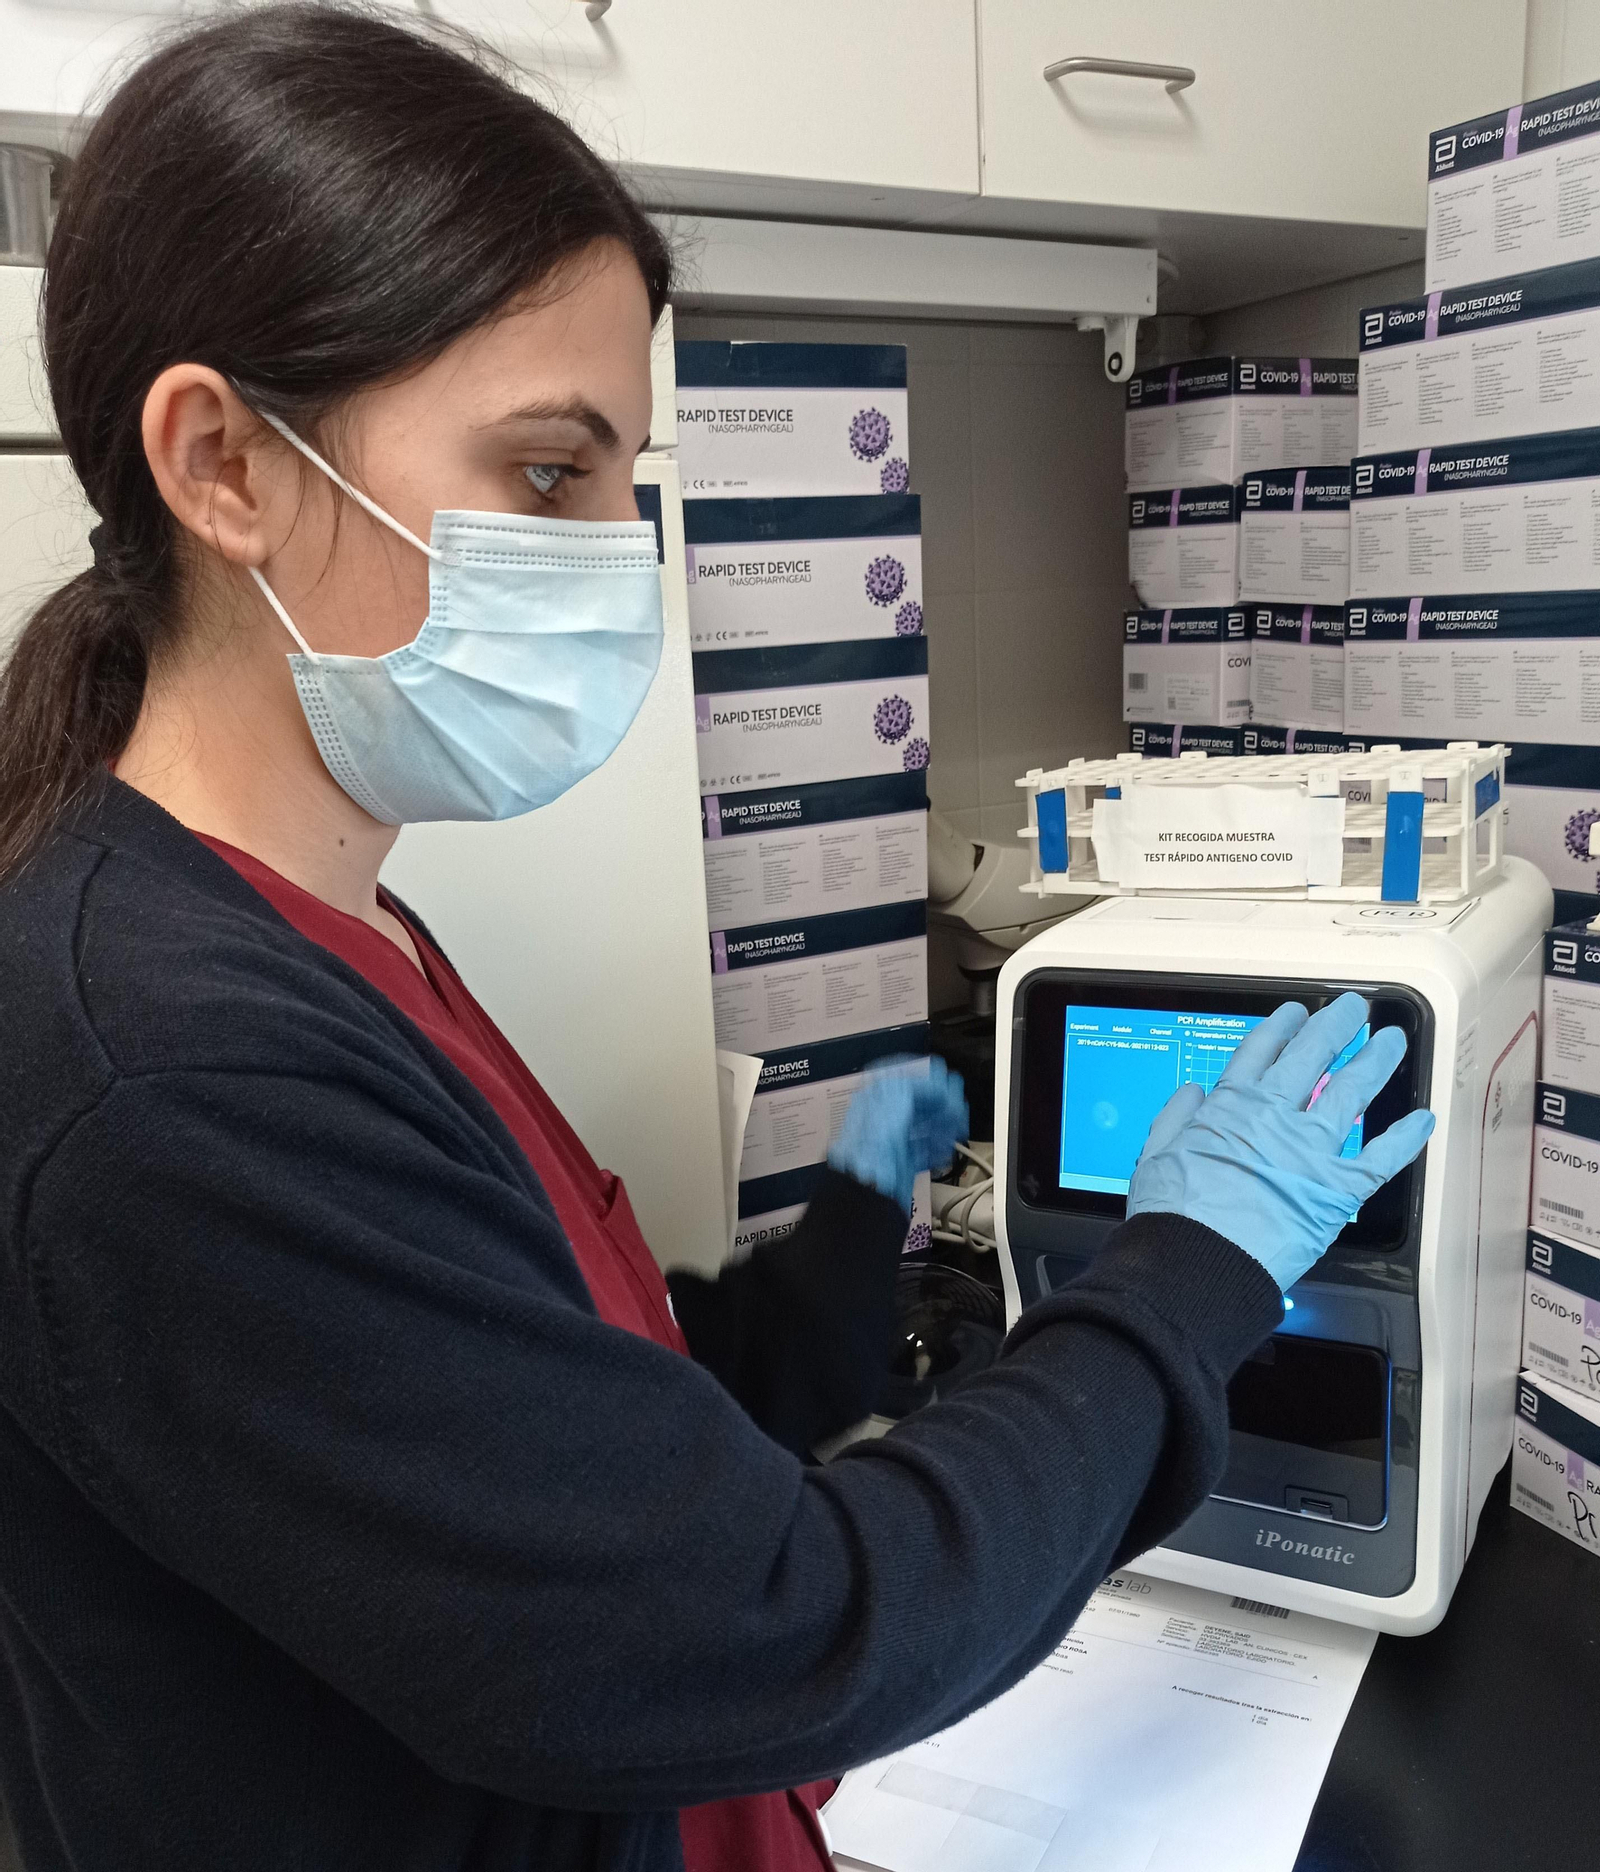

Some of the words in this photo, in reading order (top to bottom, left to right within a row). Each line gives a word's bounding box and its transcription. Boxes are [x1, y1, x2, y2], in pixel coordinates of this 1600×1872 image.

[1461, 127, 1504, 149] COVID-19
[1520, 112, 1551, 132] RAPID
[1552, 105, 1575, 123] TEST
[1388, 311, 1426, 327] COVID-19
[1440, 301, 1467, 316] RAPID
[1467, 297, 1488, 310] TEST
[1488, 290, 1523, 307] DEVICE
[1455, 302, 1521, 323] (NASOPHARYNGEAL)
[1177, 377, 1194, 388] RAPID
[1193, 374, 1206, 386] TEST
[1206, 372, 1229, 385] DEVICE
[1260, 372, 1299, 384] COVID-19
[1313, 372, 1336, 384] RAPID
[1337, 372, 1357, 384] TEST
[677, 409, 716, 423] RAPID
[717, 409, 747, 423] TEST
[749, 409, 794, 423] DEVICE
[708, 423, 794, 434] (NASOPHARYNGEAL)
[1378, 465, 1415, 479] COVID-19
[1429, 460, 1455, 473] RAPID
[1456, 458, 1476, 471] TEST
[1476, 454, 1510, 468] DEVICE
[1444, 467, 1508, 481] (NASOPHARYNGEAL)
[1265, 486, 1294, 498] COVID-19
[1304, 486, 1325, 496] RAPID
[1325, 486, 1342, 496] TEST
[1179, 502, 1195, 512] RAPID
[1195, 501, 1210, 511] TEST
[1209, 501, 1230, 511] DEVICE
[698, 563, 737, 578] RAPID
[738, 562, 766, 577] TEST
[768, 560, 811, 575] DEVICE
[729, 573, 812, 587] (NASOPHARYNGEAL)
[1371, 612, 1407, 623] COVID-19
[1420, 611, 1446, 622] RAPID
[1447, 610, 1467, 622] TEST
[1467, 609, 1499, 621] DEVICE
[1170, 621, 1186, 631] RAPID
[1185, 621, 1199, 631] TEST
[1198, 620, 1218, 630] DEVICE
[1275, 618, 1302, 628] COVID-19
[1311, 620, 1330, 631] RAPID
[1329, 622, 1345, 631] TEST
[1435, 620, 1498, 631] (NASOPHARYNGEAL)
[712, 710, 751, 726] RAPID
[751, 707, 778, 722] TEST
[780, 703, 822, 719] DEVICE
[742, 717, 823, 734] (NASOPHARYNGEAL)
[1148, 735, 1172, 746] COVID-19
[1180, 737, 1197, 747] RAPID
[1197, 738, 1212, 748] TEST
[1211, 739, 1234, 749] DEVICE
[1260, 739, 1285, 750] COVID-19
[1294, 742, 1314, 752] RAPID
[1314, 743, 1329, 753] TEST
[721, 805, 748, 819] RAPID
[749, 803, 769, 817] TEST
[769, 799, 802, 813] DEVICE
[739, 810, 802, 826] (NASOPHARYNGEAL)
[1158, 832, 1174, 842] KIT
[1175, 832, 1224, 842] RECOGIDA
[1225, 831, 1275, 842] MUESTRA
[1144, 853, 1166, 862] TEST
[1167, 850, 1204, 863] RÁPIDO
[1206, 853, 1258, 863] ANTIGENO
[1260, 852, 1293, 862] COVID
[727, 939, 754, 954] RAPID
[754, 936, 774, 949] TEST
[774, 932, 805, 946] DEVICE
[744, 942, 806, 959] (NASOPHARYNGEAL)
[1552, 964, 1576, 974] Abbott
[1177, 1015, 1194, 1026] PCR
[1195, 1017, 1246, 1029] Amplification
[1069, 1023, 1099, 1033] Experiment
[1112, 1025, 1133, 1033] Module
[1149, 1029, 1172, 1037] Channel
[1192, 1030, 1226, 1041] Temperature
[1226, 1034, 1245, 1042] Curve
[760, 1065, 778, 1078] TEST
[778, 1058, 810, 1073] DEVICE
[1542, 1114, 1565, 1126] Abbott
[1541, 1147, 1599, 1174] COVID-19
[735, 1228, 768, 1247] RAPID
[769, 1222, 793, 1238] TEST
[1530, 1293, 1582, 1325] COVID-19
[1518, 1437, 1566, 1474] COVID-19
[1255, 1529, 1355, 1565] iPonatic
[1126, 1580, 1152, 1595] lab
[1178, 1687, 1204, 1696] recoger
[1204, 1693, 1240, 1706] resultados
[1263, 1708, 1300, 1719] extracción
